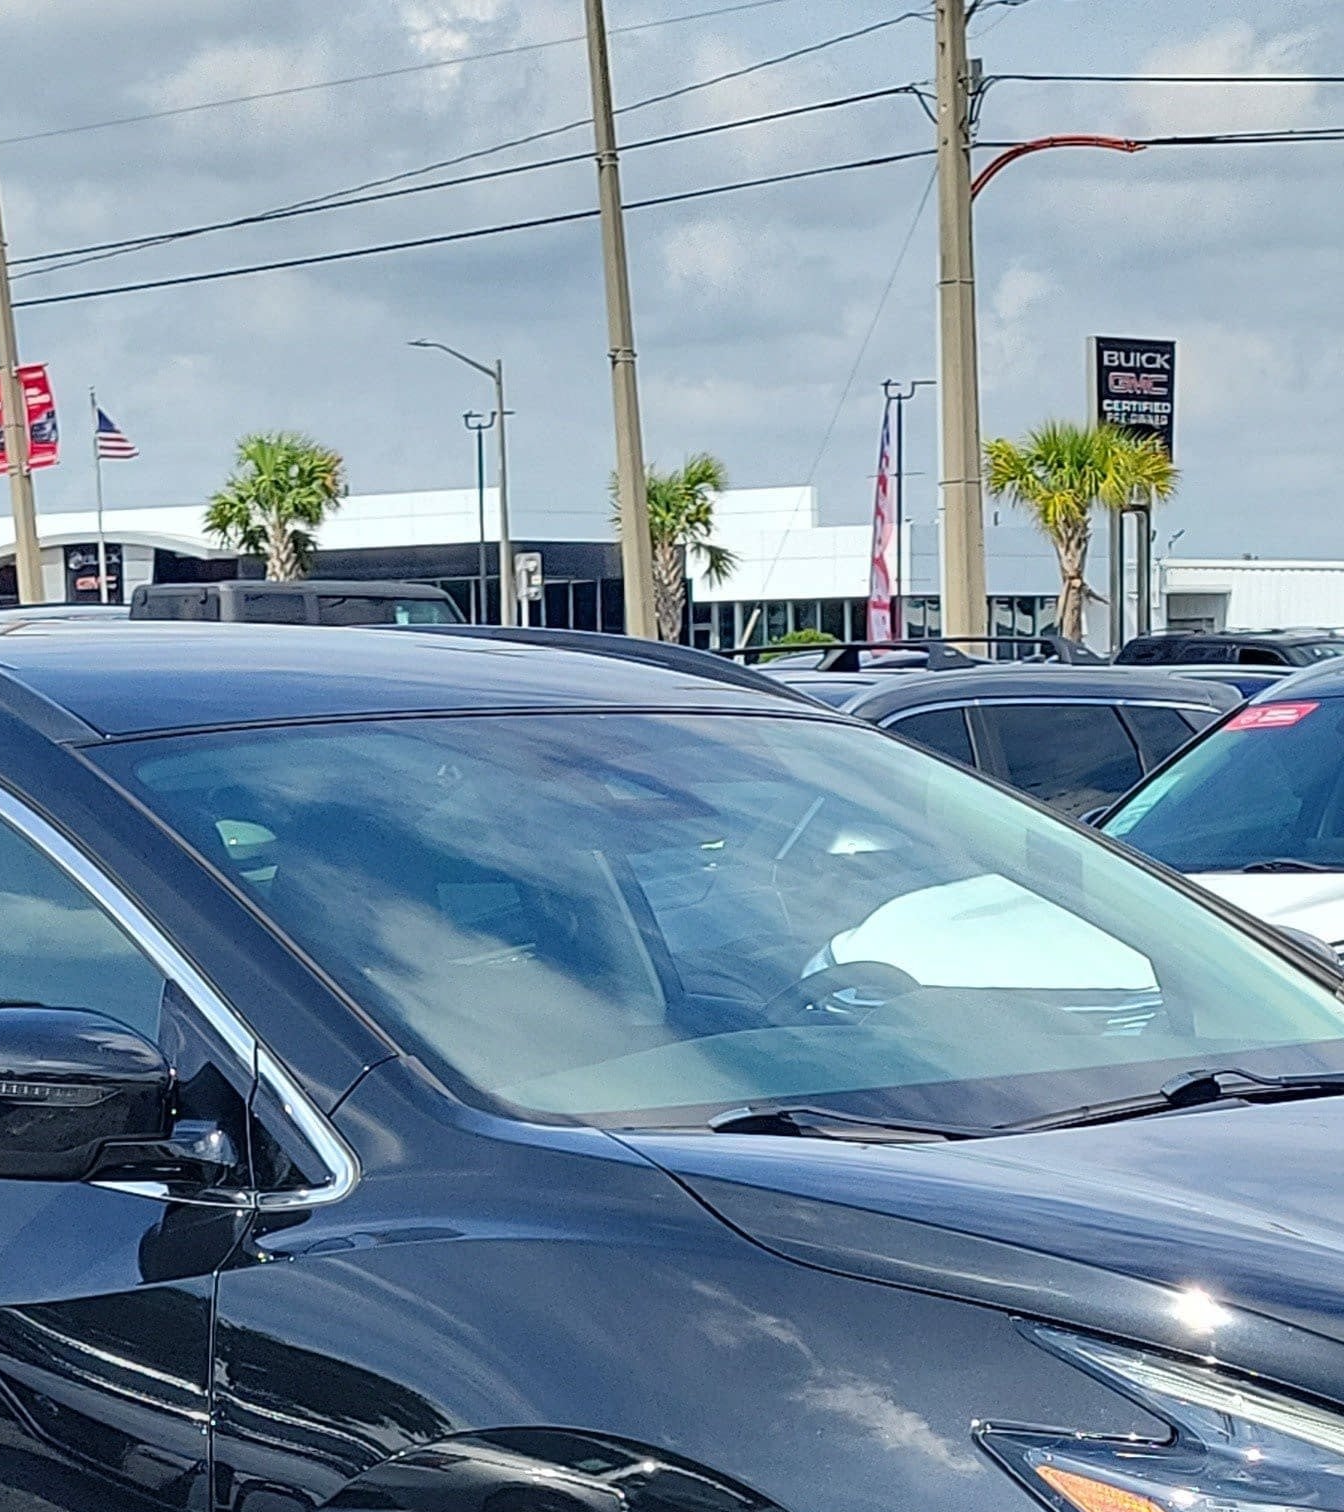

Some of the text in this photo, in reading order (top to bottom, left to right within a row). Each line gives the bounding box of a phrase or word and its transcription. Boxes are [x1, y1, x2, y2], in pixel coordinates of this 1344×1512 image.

[1103, 350, 1171, 369] BUICK
[1108, 372, 1169, 395] GMC
[1102, 399, 1172, 414] CERTIFIED
